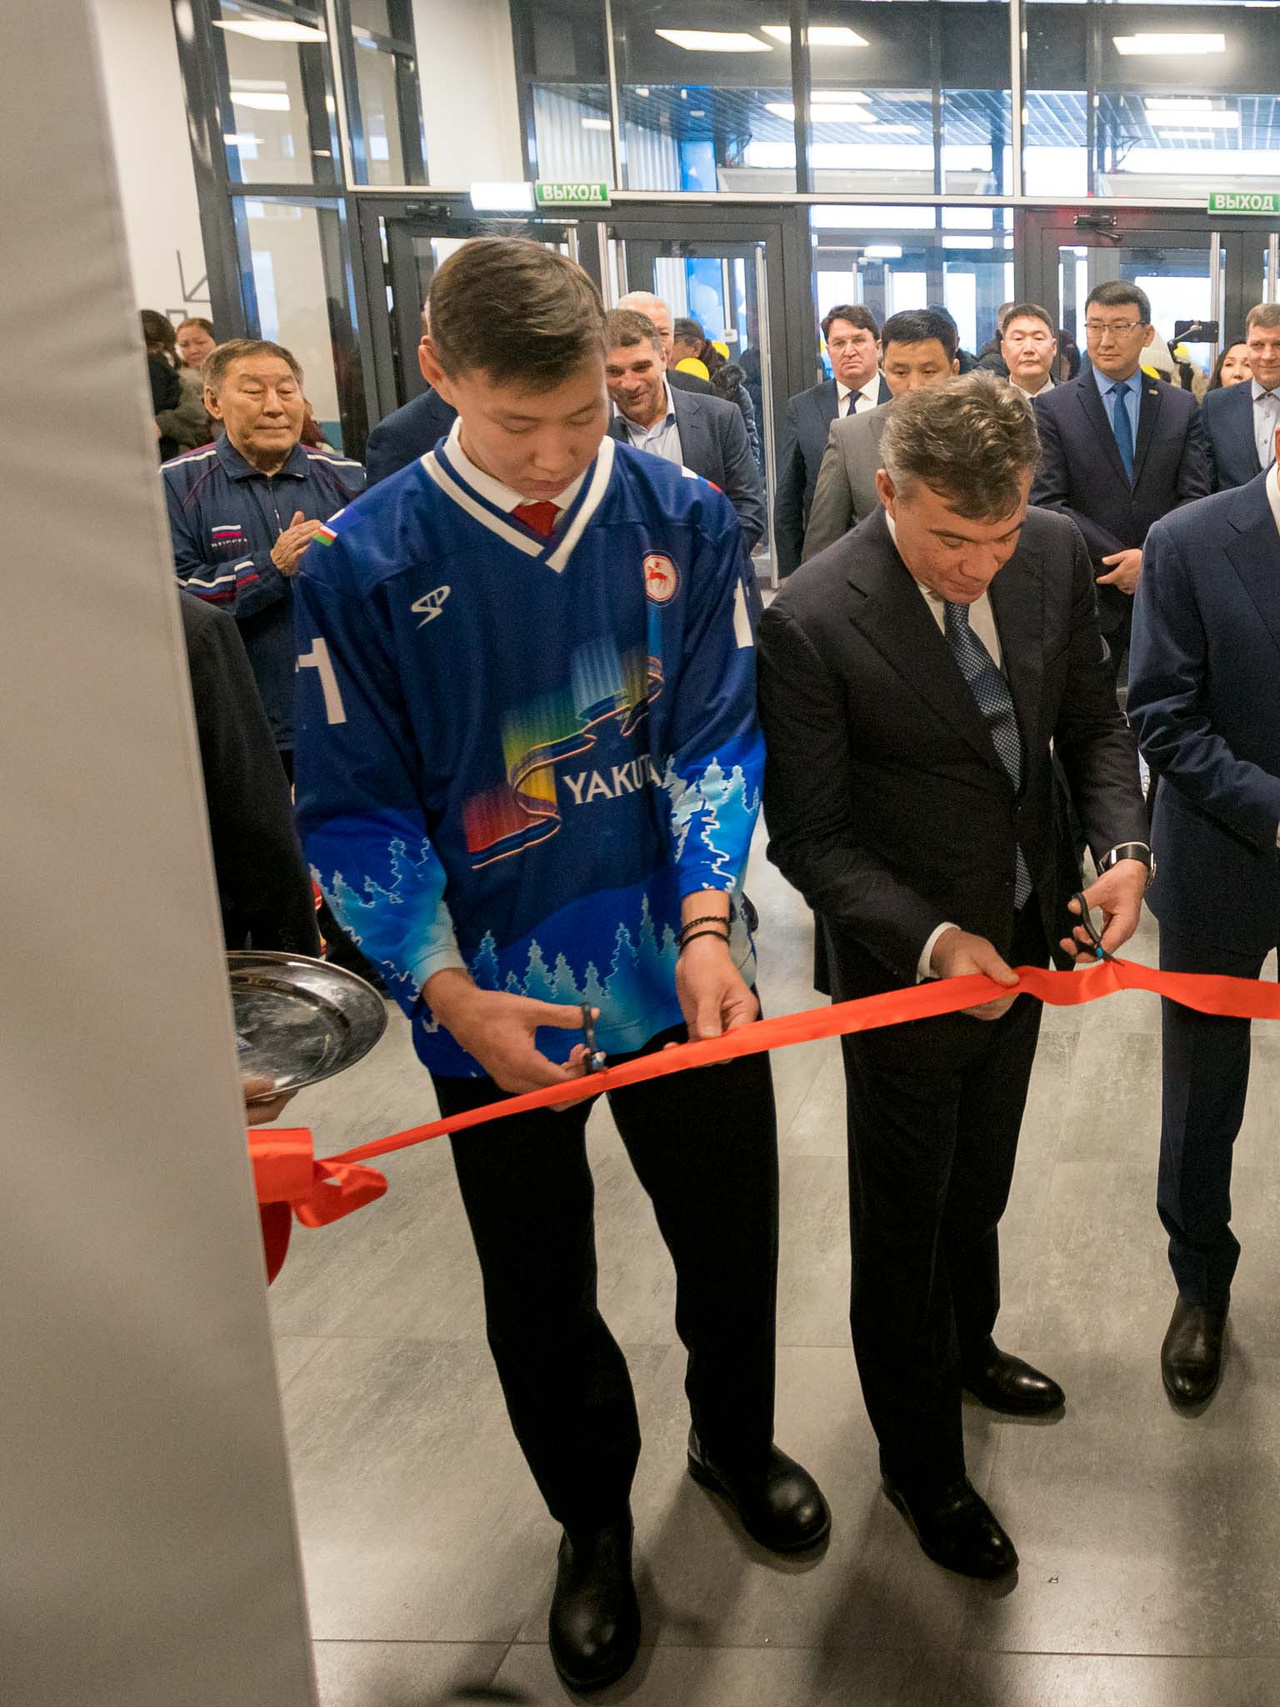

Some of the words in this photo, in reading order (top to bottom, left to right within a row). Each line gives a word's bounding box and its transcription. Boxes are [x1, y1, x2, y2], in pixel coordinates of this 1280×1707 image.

[543, 184, 603, 201] ВЫХОД
[1215, 194, 1274, 211] ВЫХОД
[296, 637, 348, 725] 1
